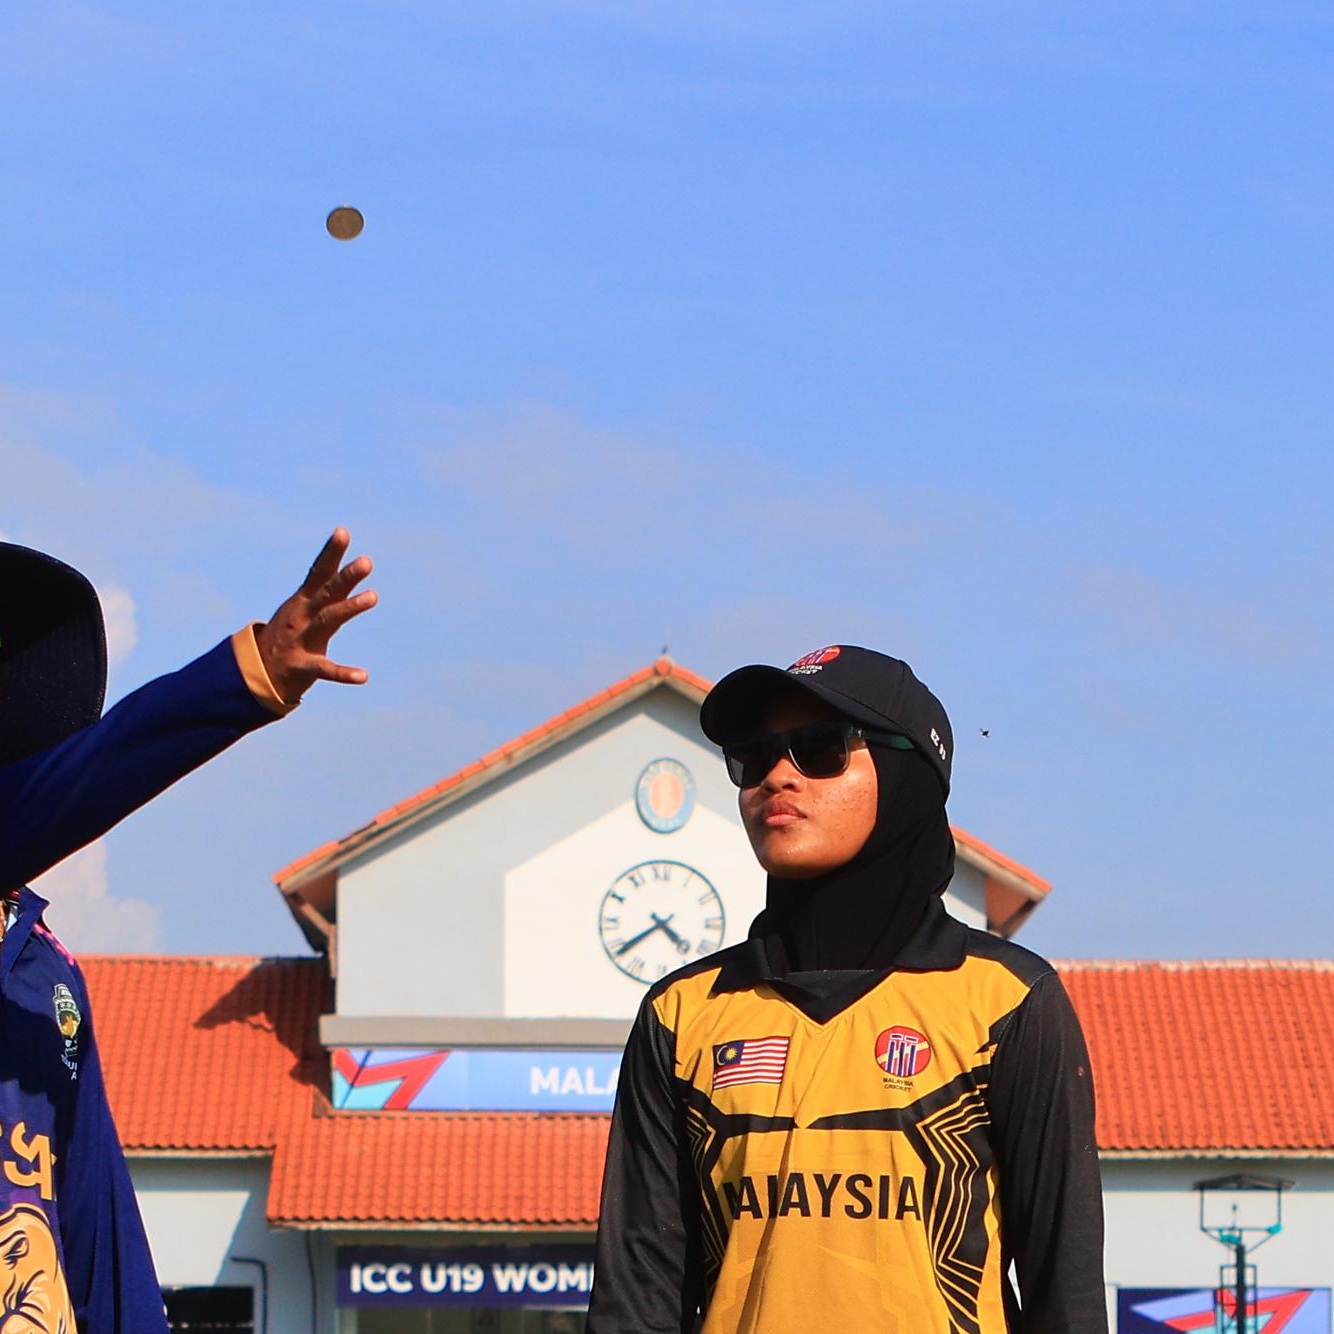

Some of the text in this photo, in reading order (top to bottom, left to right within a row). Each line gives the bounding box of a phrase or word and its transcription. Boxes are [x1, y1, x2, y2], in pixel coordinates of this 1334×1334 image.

[350, 1262, 595, 1293] ICC U19 WOM
